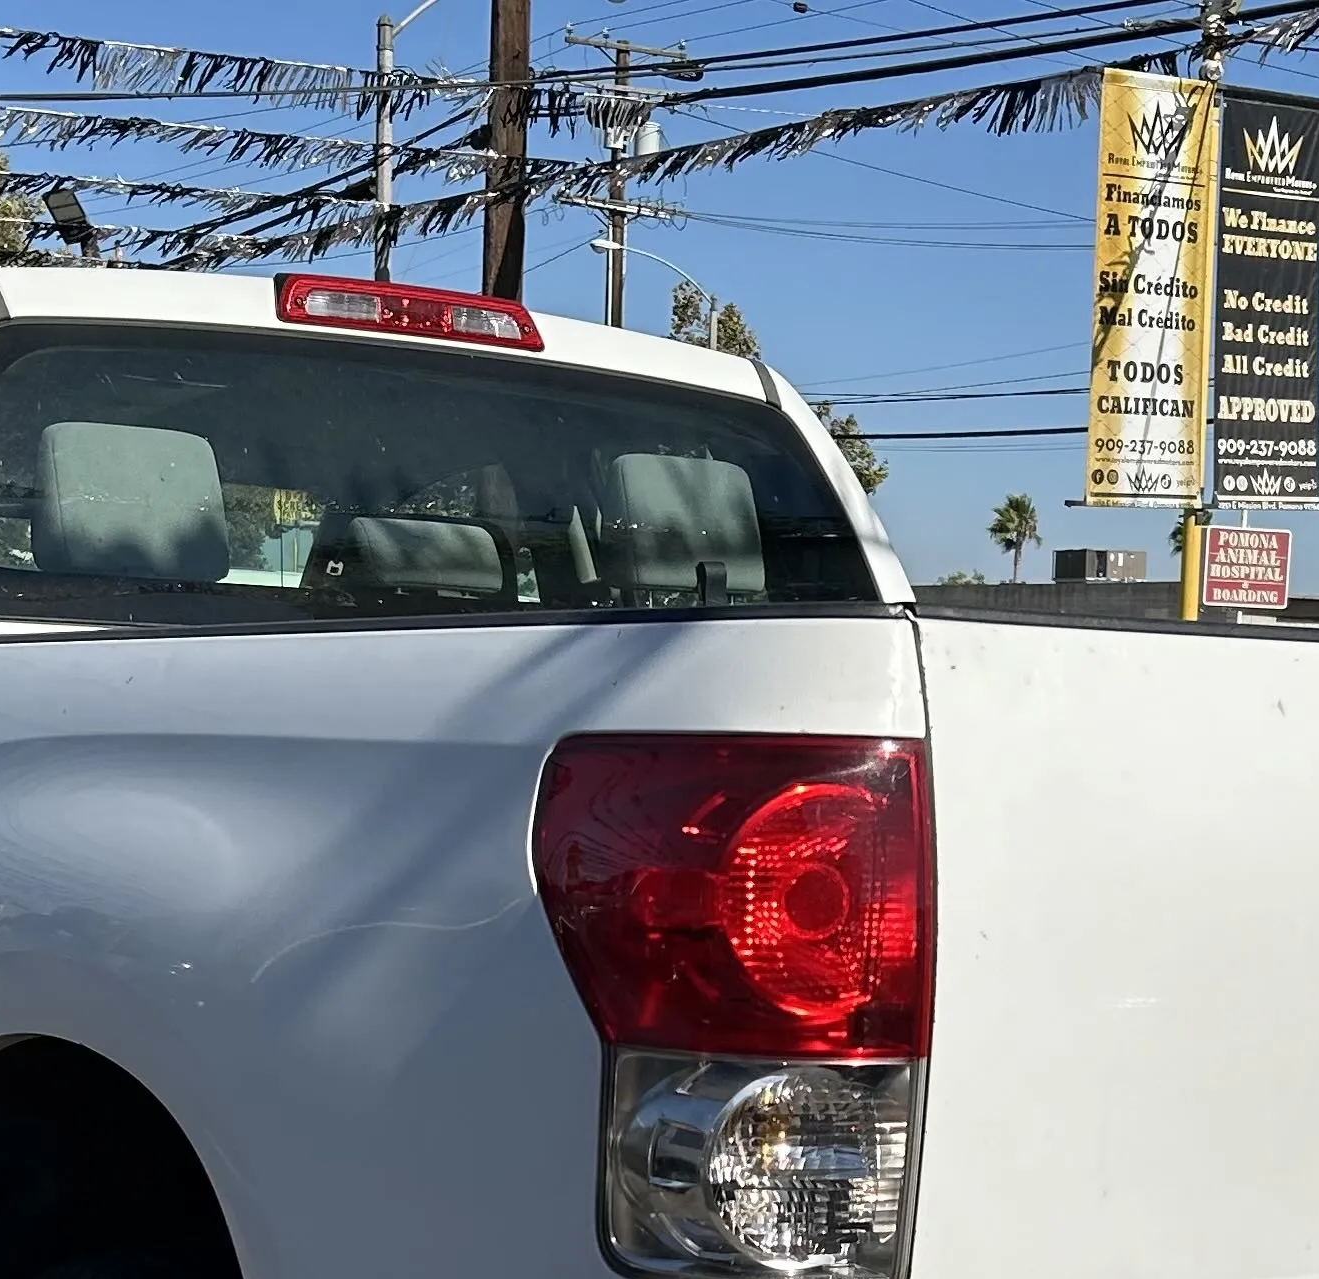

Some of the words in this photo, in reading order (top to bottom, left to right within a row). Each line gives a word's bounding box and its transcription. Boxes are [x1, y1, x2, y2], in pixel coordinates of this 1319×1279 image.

[1105, 184, 1201, 211] Financiamos
[1104, 213, 1121, 236] A
[1128, 215, 1198, 243] TODOS
[1222, 206, 1248, 228] We
[1250, 210, 1316, 235] Finance
[1222, 233, 1317, 261] EVERYONE
[1099, 271, 1128, 293] Sin
[1133, 274, 1198, 299] Crédito
[1223, 289, 1249, 310] No
[1252, 291, 1309, 314] Credit
[1099, 306, 1132, 326] Mal
[1137, 309, 1195, 331] Crédito
[1222, 321, 1253, 342] Bad
[1258, 324, 1309, 346] Credit
[1107, 360, 1184, 385] TODOS
[1222, 354, 1248, 374] All
[1252, 356, 1309, 378] Credit
[1097, 395, 1194, 418] CALIFICAN
[1218, 395, 1315, 423] APPROVED
[1095, 438, 1194, 456] 909-237-9088
[1217, 438, 1316, 457] 909-237-9088
[1218, 531, 1278, 549] POMONA
[1215, 547, 1281, 566] ANIMAL
[1210, 564, 1283, 581] HOSPITAL
[1213, 588, 1278, 603] BOARDING
